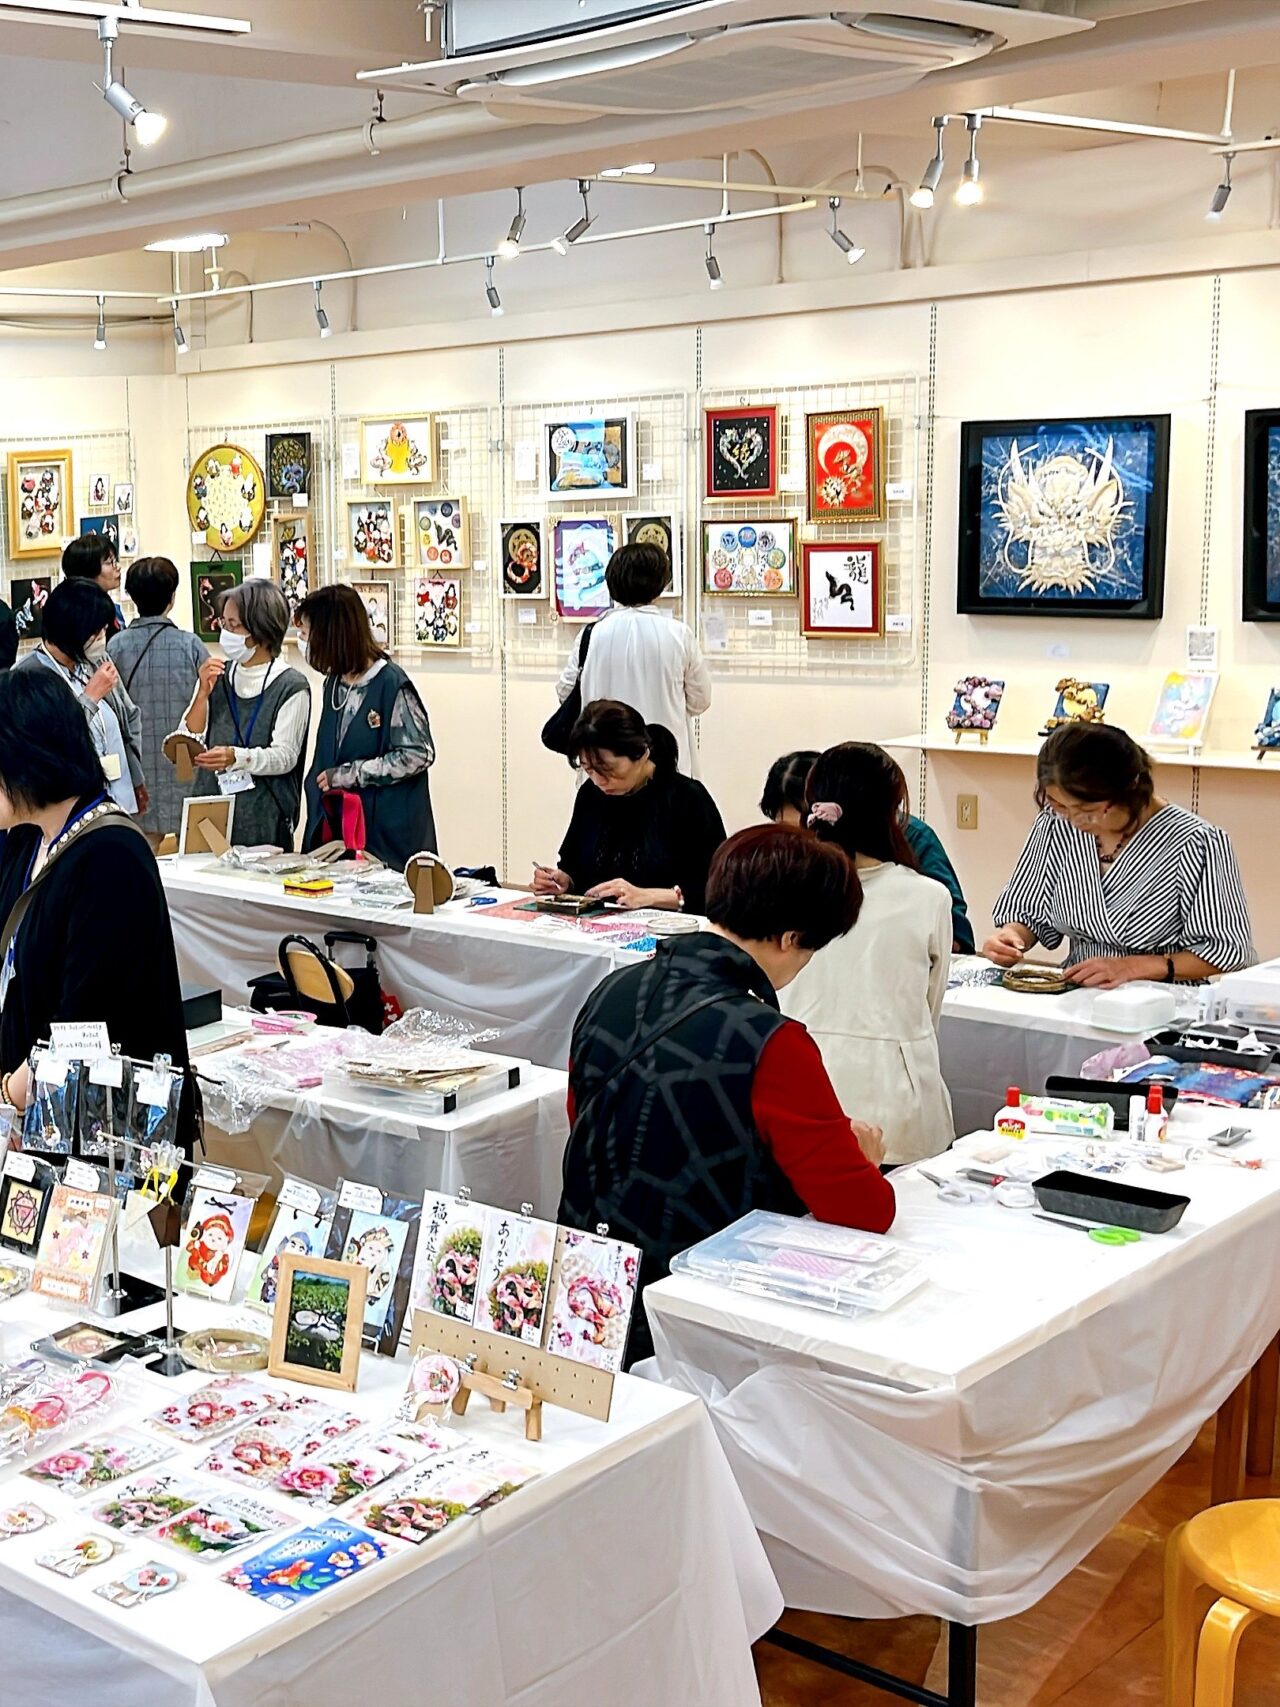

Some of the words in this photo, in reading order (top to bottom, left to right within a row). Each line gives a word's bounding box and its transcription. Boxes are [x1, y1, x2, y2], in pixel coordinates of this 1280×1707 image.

[492, 1220, 510, 1281] ありがとう
